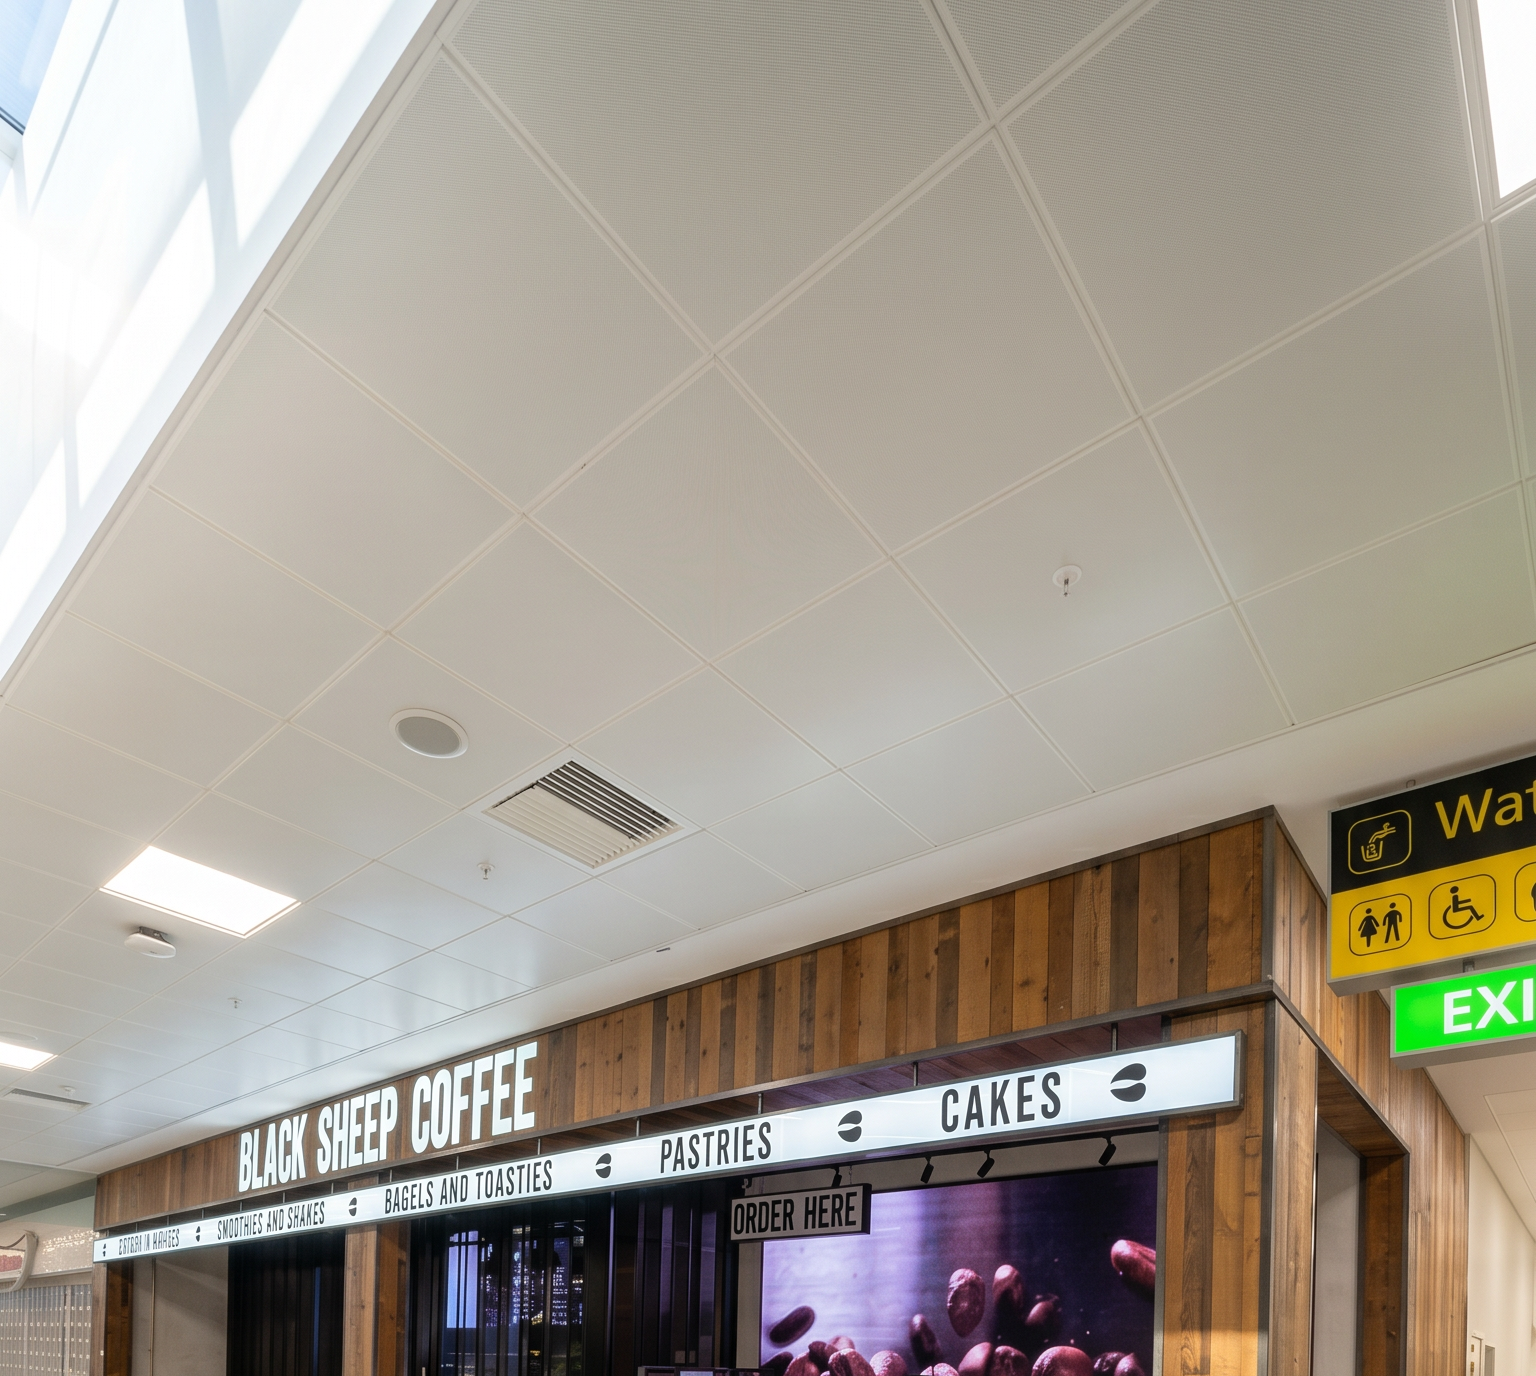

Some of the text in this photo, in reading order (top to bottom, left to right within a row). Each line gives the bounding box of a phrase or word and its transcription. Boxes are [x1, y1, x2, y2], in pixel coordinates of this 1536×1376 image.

[238, 1041, 538, 1193] BLACK SHEEP COFFEE
[941, 1071, 1062, 1133] CAKES
[660, 1121, 772, 1174] PASTRIES
[384, 1159, 553, 1215] BAGELS AND TOASTIES
[733, 1191, 858, 1235] ORDER HERE
[217, 1200, 326, 1241] SMOOTHIES AND SHAKES
